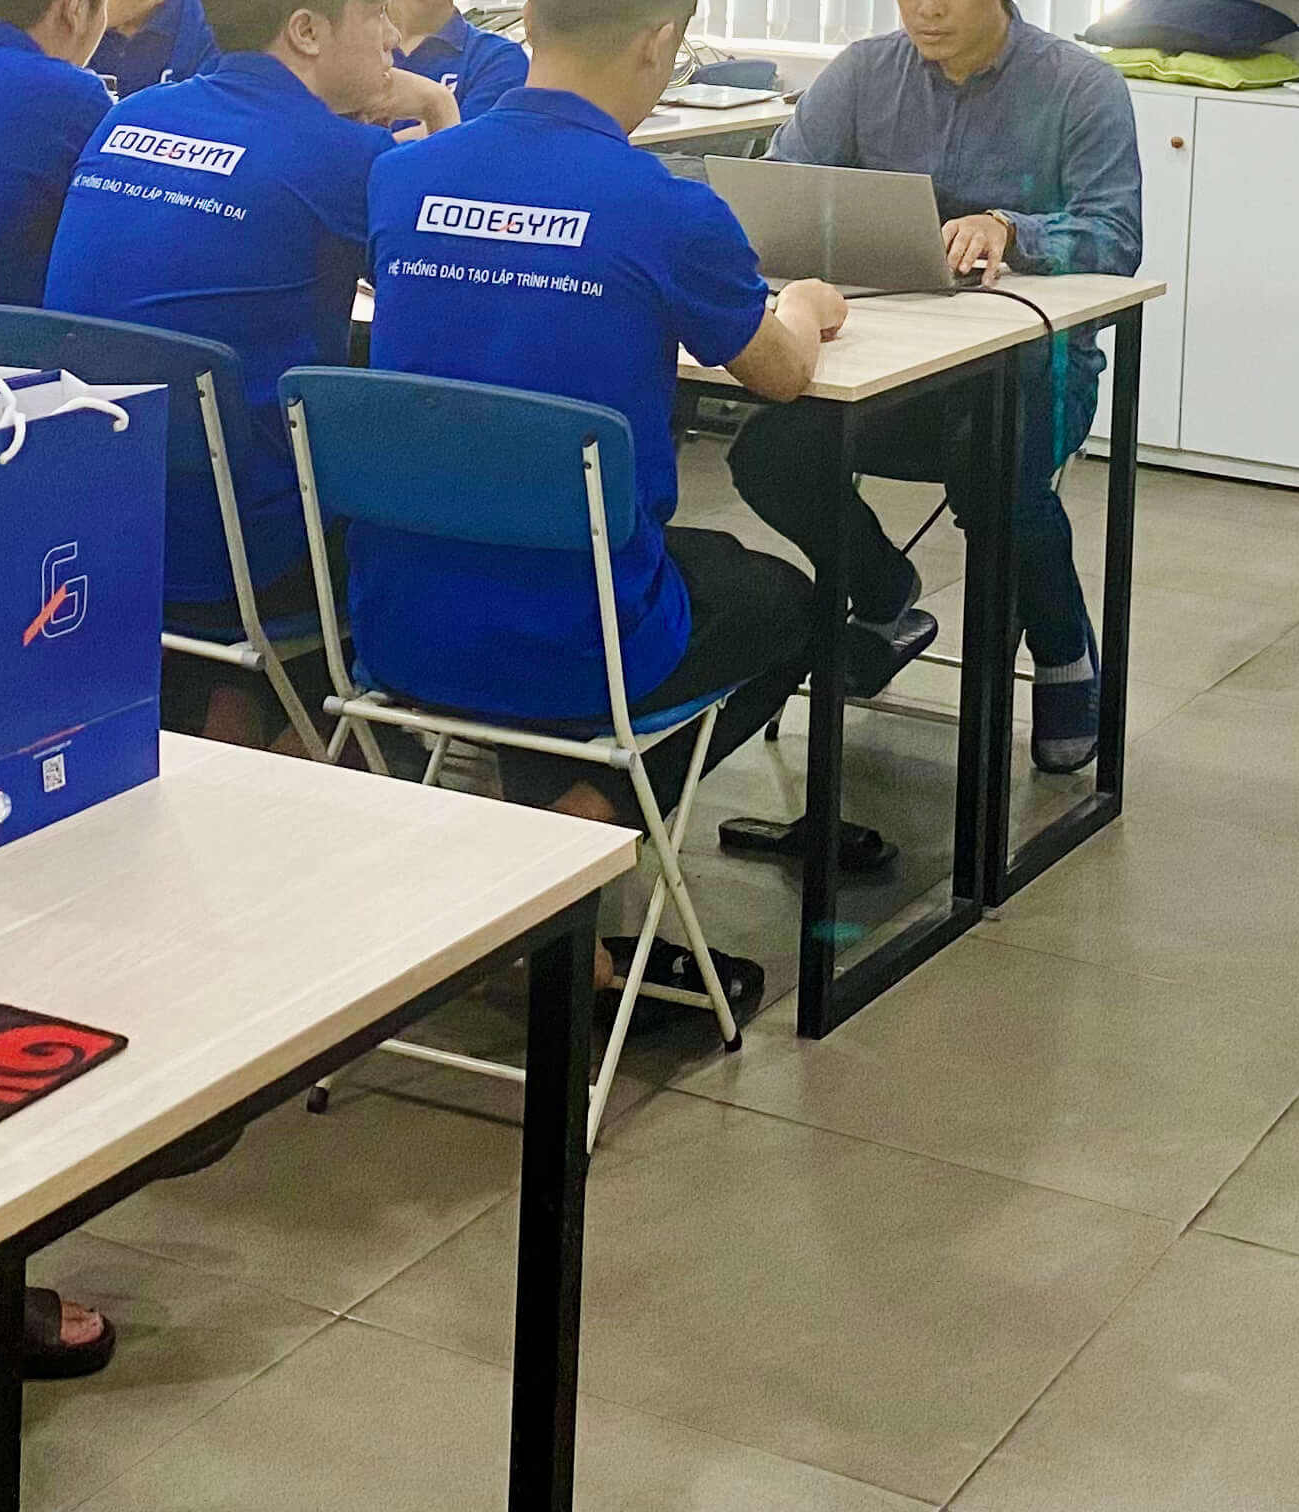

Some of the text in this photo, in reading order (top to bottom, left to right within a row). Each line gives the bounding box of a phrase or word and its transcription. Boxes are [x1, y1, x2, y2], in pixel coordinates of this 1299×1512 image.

[108, 130, 235, 169] CODEGYM
[163, 190, 195, 208] TRÌNH
[425, 202, 580, 240] CODEGYM
[401, 258, 438, 277] THỐNG
[467, 267, 490, 285] TẠO
[515, 271, 549, 289] TRÌNH
[550, 275, 579, 293] HIỆN
